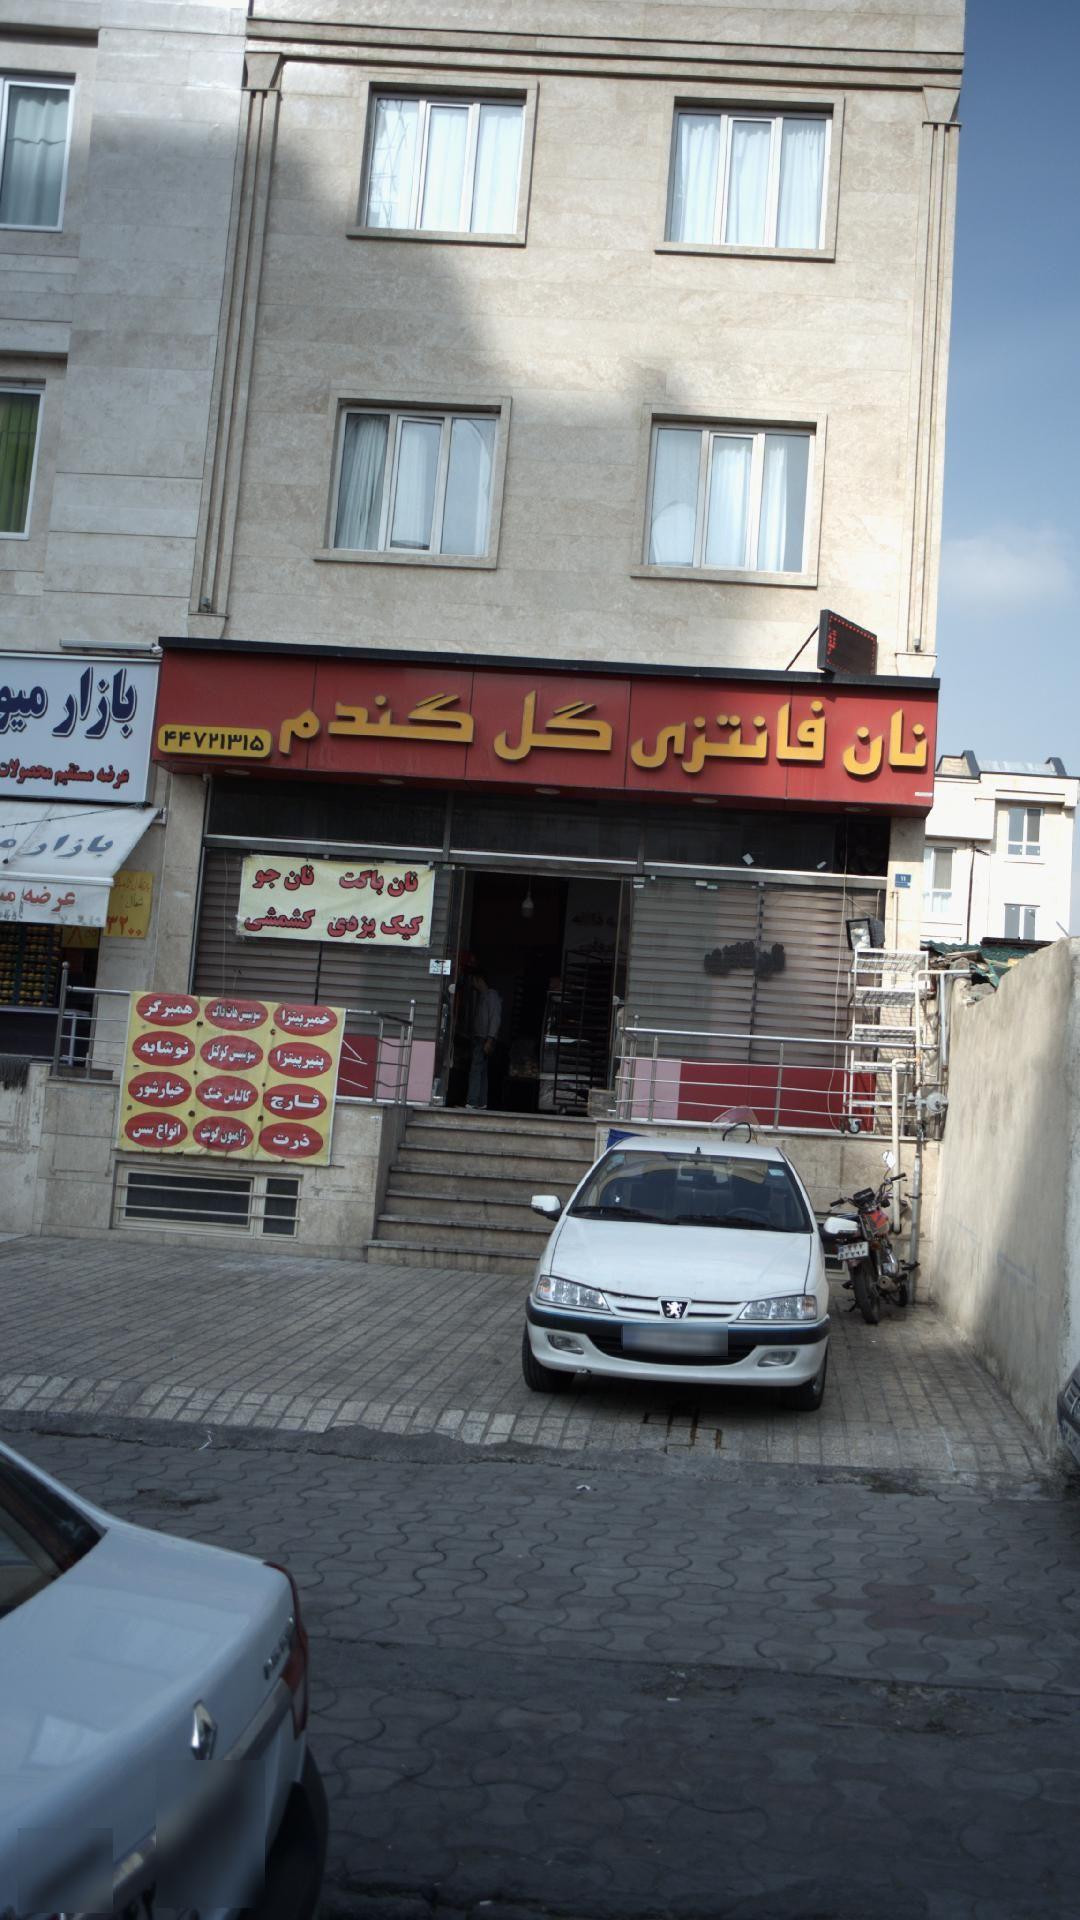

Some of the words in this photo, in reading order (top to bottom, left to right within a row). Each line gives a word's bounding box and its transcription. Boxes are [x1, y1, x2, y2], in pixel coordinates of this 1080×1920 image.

[52, 666, 137, 739] بازار
[279, 693, 475, 756] گندم
[493, 690, 613, 762] گل
[164, 730, 264, 752] ۴۴۷۲۱۳۱۵
[631, 700, 827, 774] فانتزی
[843, 708, 928, 776] نان
[54, 762, 95, 786] مستقیم
[96, 764, 130, 789] عرضه
[21, 834, 114, 858] بازار
[252, 868, 281, 889] جو
[284, 865, 315, 891] نان
[387, 870, 419, 897] نان
[23, 885, 76, 912] عرضه
[244, 906, 316, 932] کشمشی
[327, 915, 377, 939] یزدی
[380, 915, 424, 940] کیک
[238, 1012, 261, 1024] سوسیس
[140, 1040, 189, 1058] نوشابه
[229, 1051, 256, 1064] سوسیس
[203, 1087, 223, 1100] خشک
[223, 1088, 251, 1104] کالباس
[270, 1094, 320, 1111] قارچ
[132, 1127, 154, 1138] سس
[156, 1122, 181, 1141] انواع
[220, 1128, 247, 1146] ژامبون
[272, 1133, 310, 1150] ذرت
